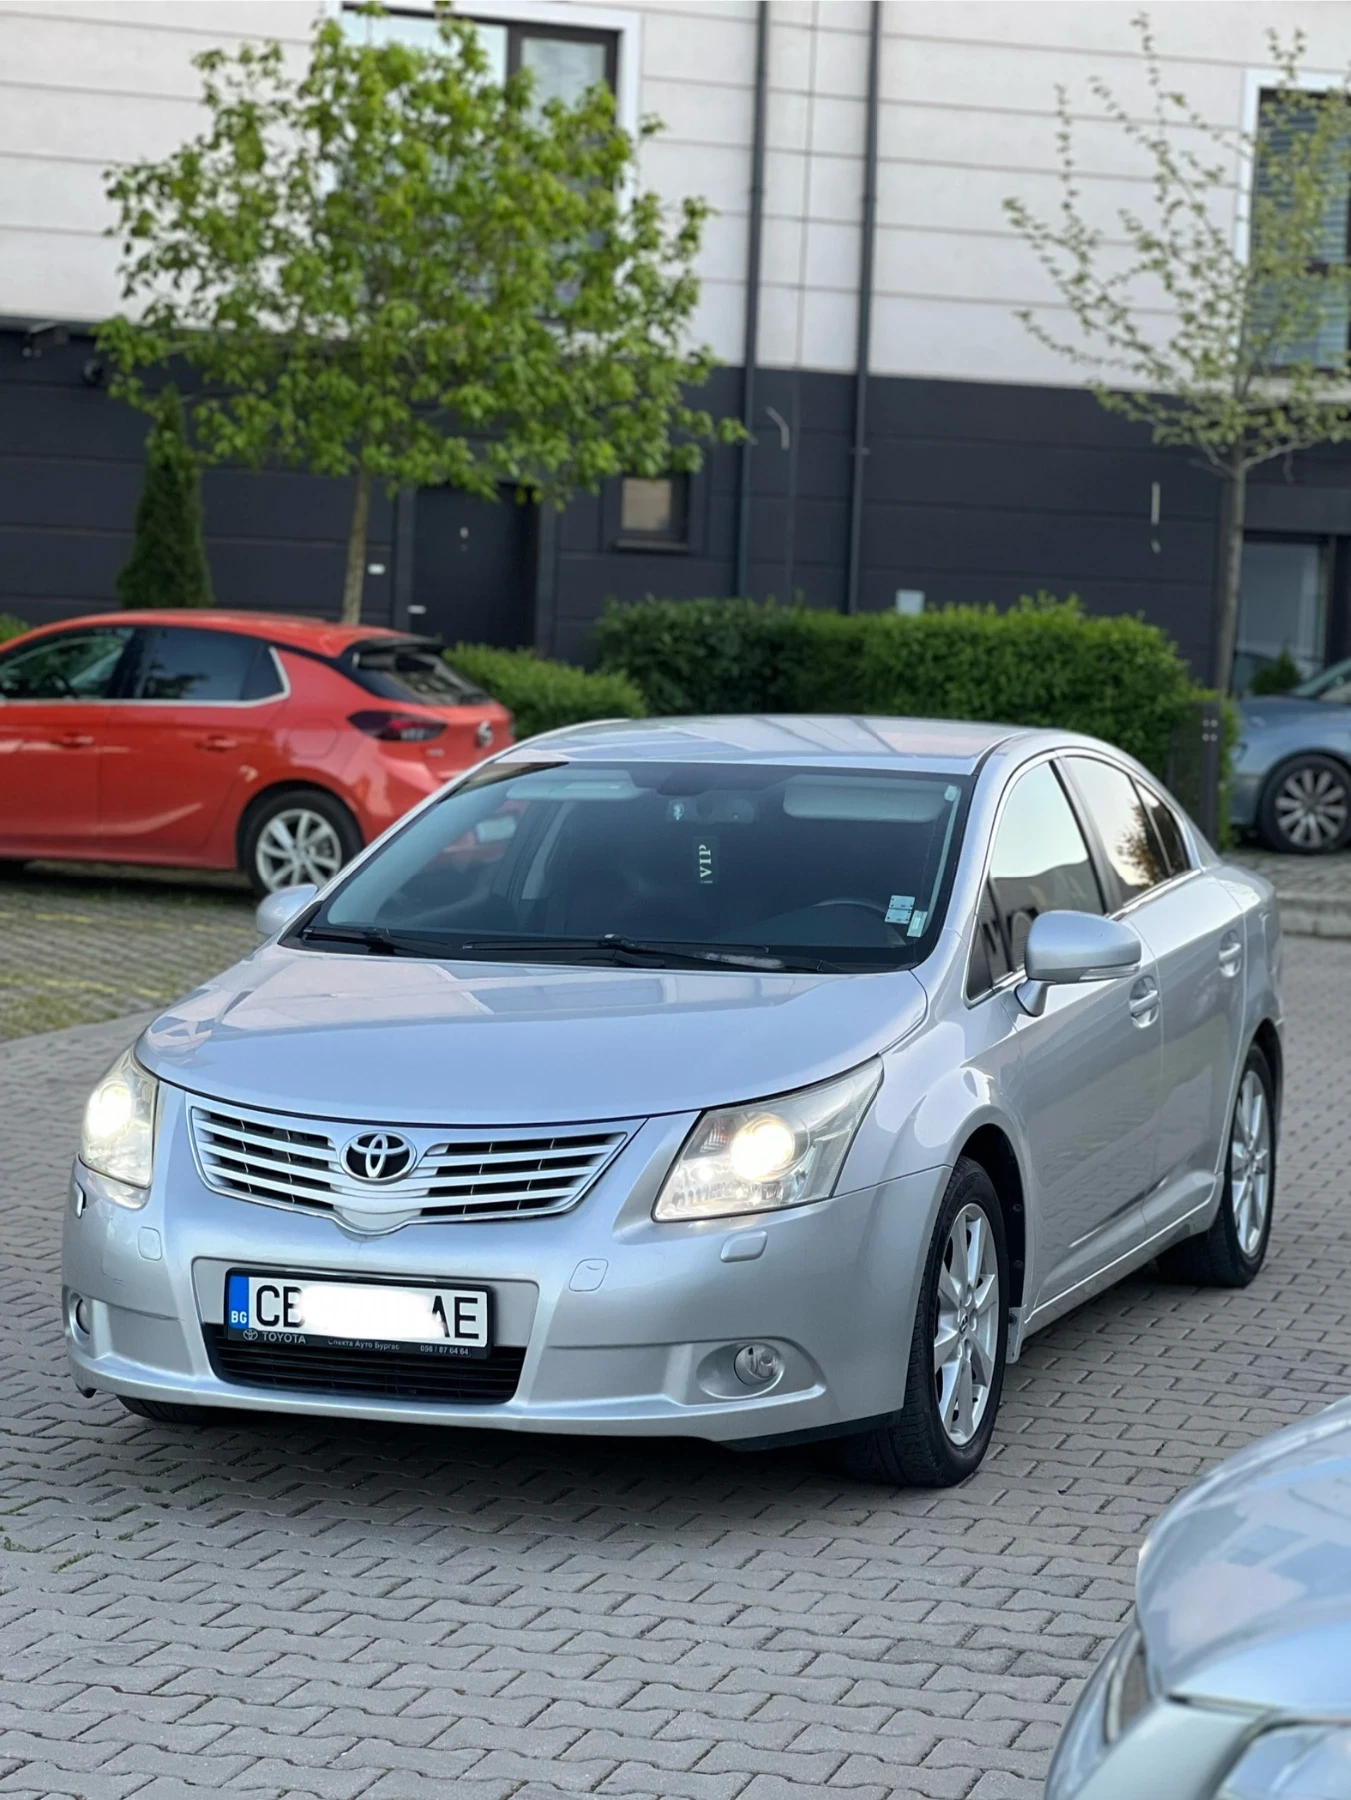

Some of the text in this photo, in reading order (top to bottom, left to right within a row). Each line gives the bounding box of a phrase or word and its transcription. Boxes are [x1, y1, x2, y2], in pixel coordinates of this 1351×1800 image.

[698, 843, 712, 878] VIP
[230, 1310, 248, 1324] BG
[261, 1331, 306, 1344] TOYOTA
